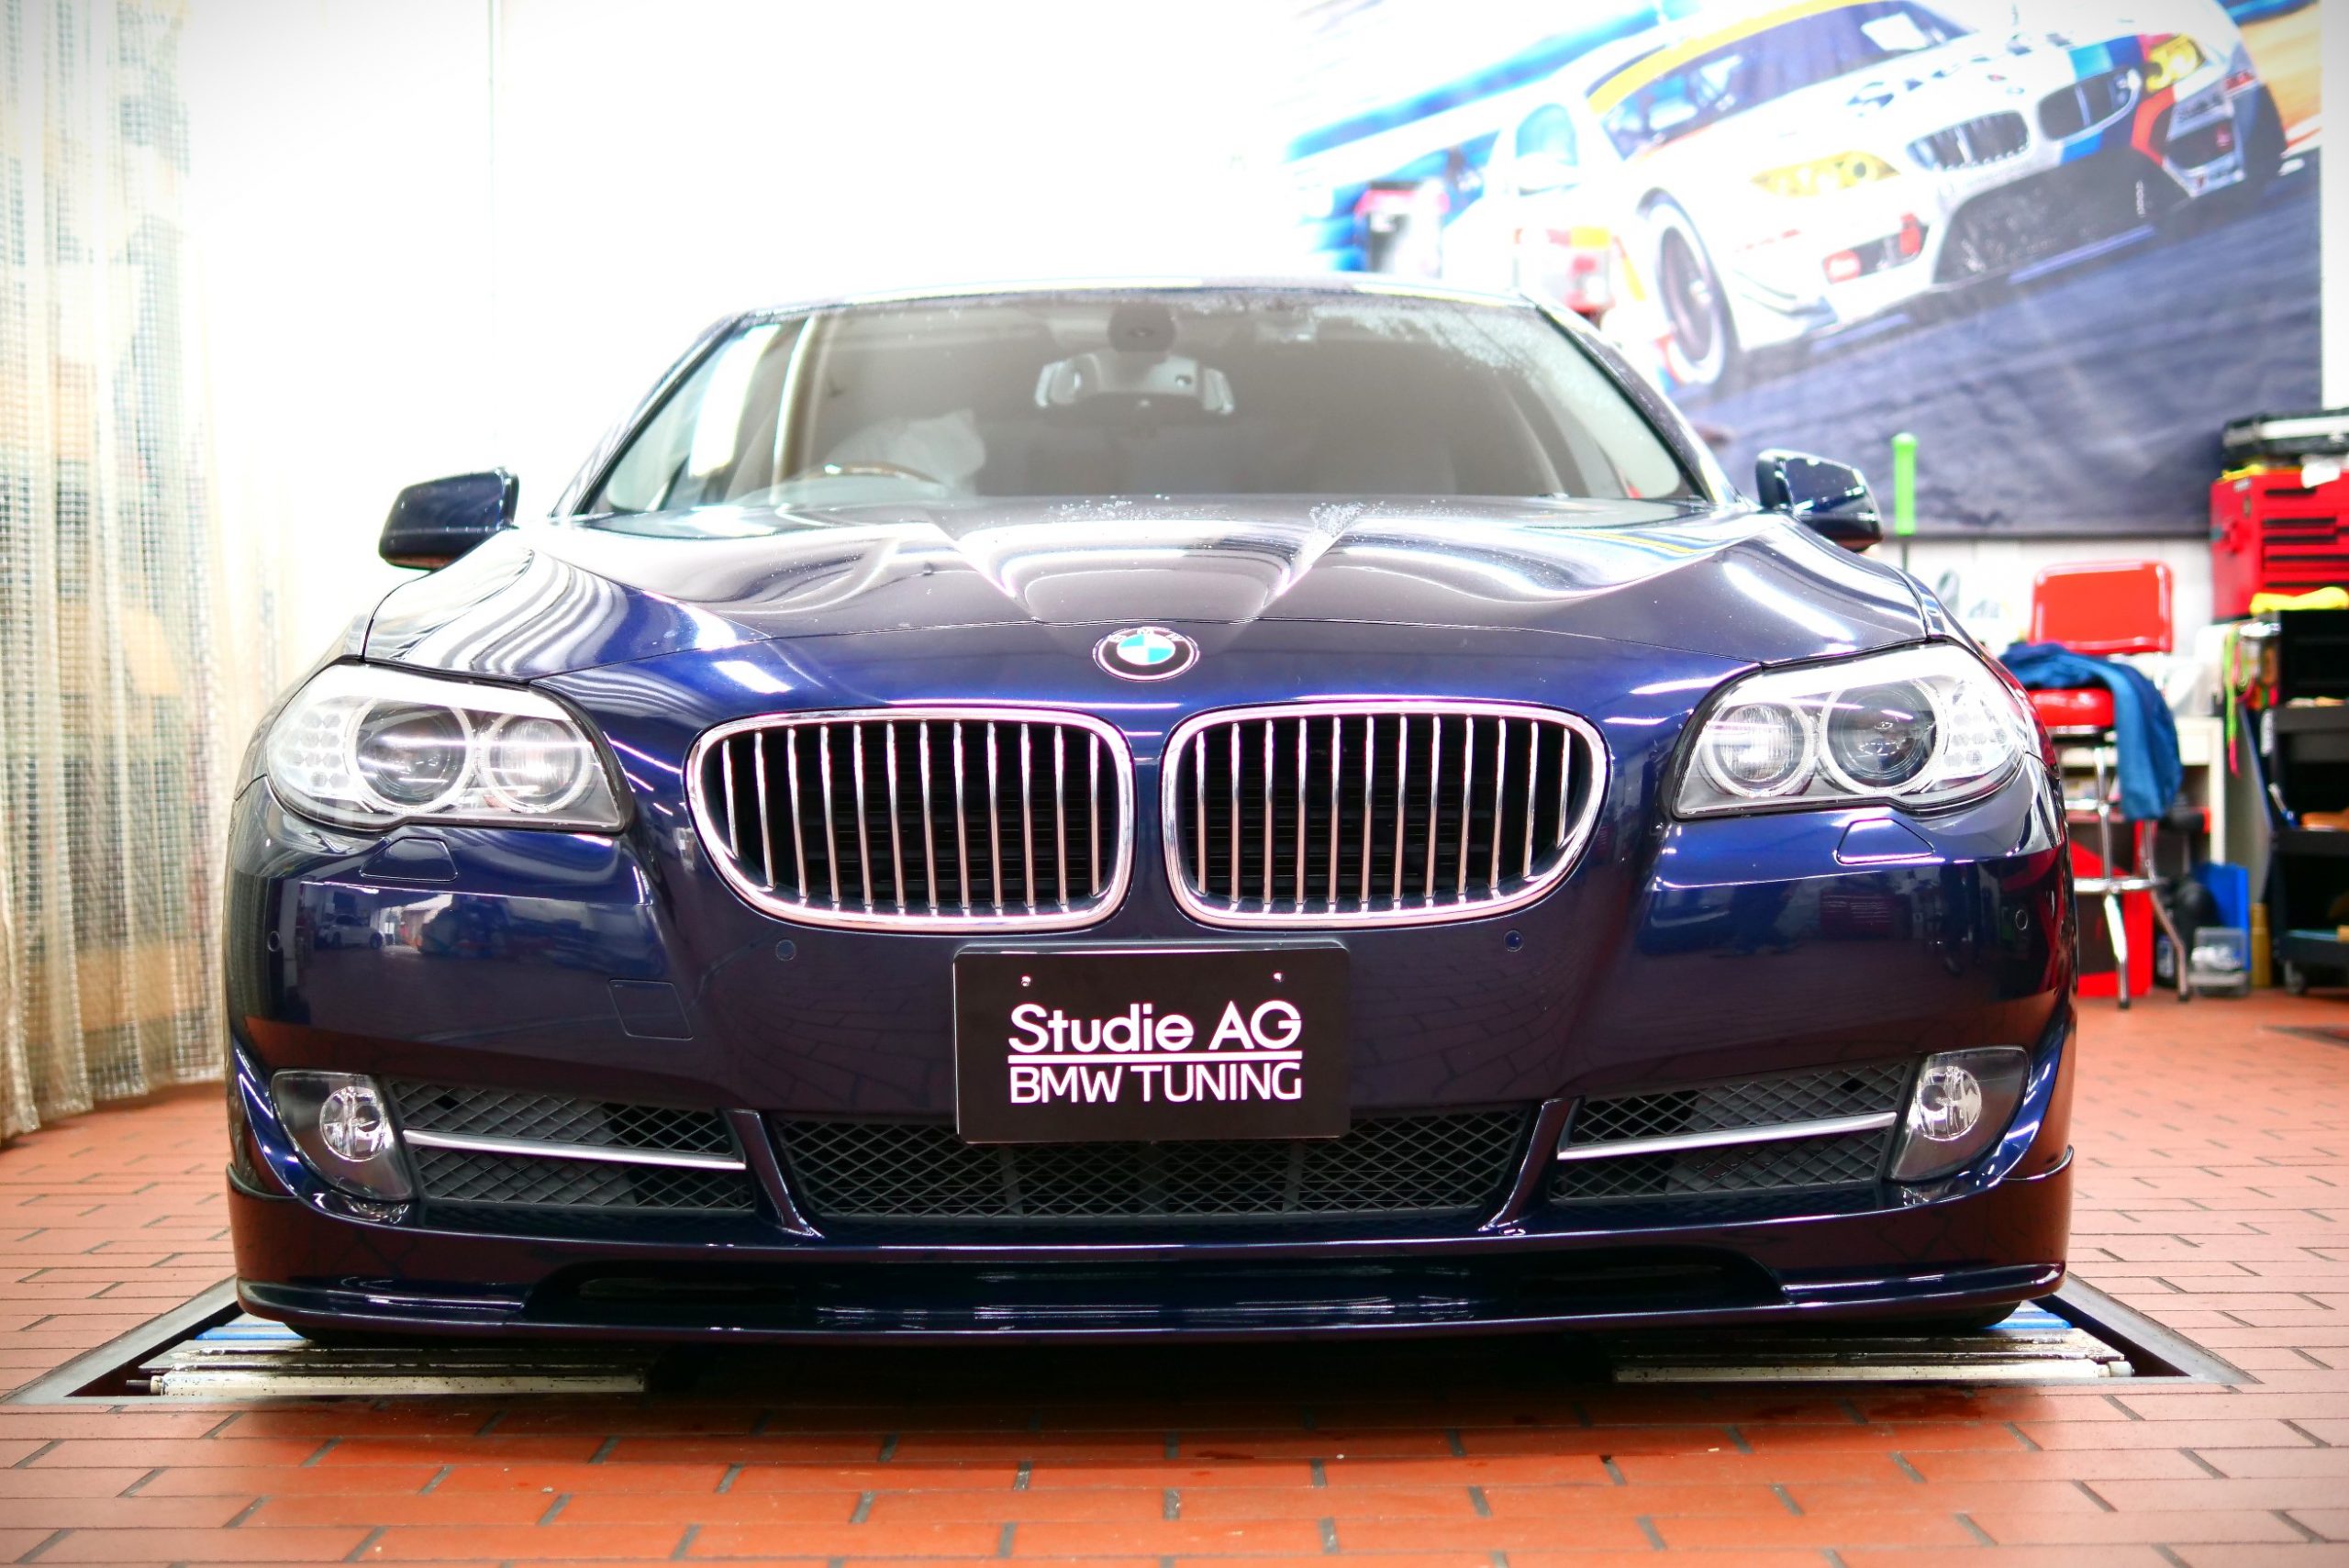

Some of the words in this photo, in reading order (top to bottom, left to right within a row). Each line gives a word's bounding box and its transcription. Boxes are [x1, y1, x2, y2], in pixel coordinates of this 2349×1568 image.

[1008, 1003, 1194, 1052] Studie
[1208, 1000, 1302, 1050] AG
[1010, 1066, 1122, 1103] BMW
[1130, 1062, 1302, 1102] TUNING
